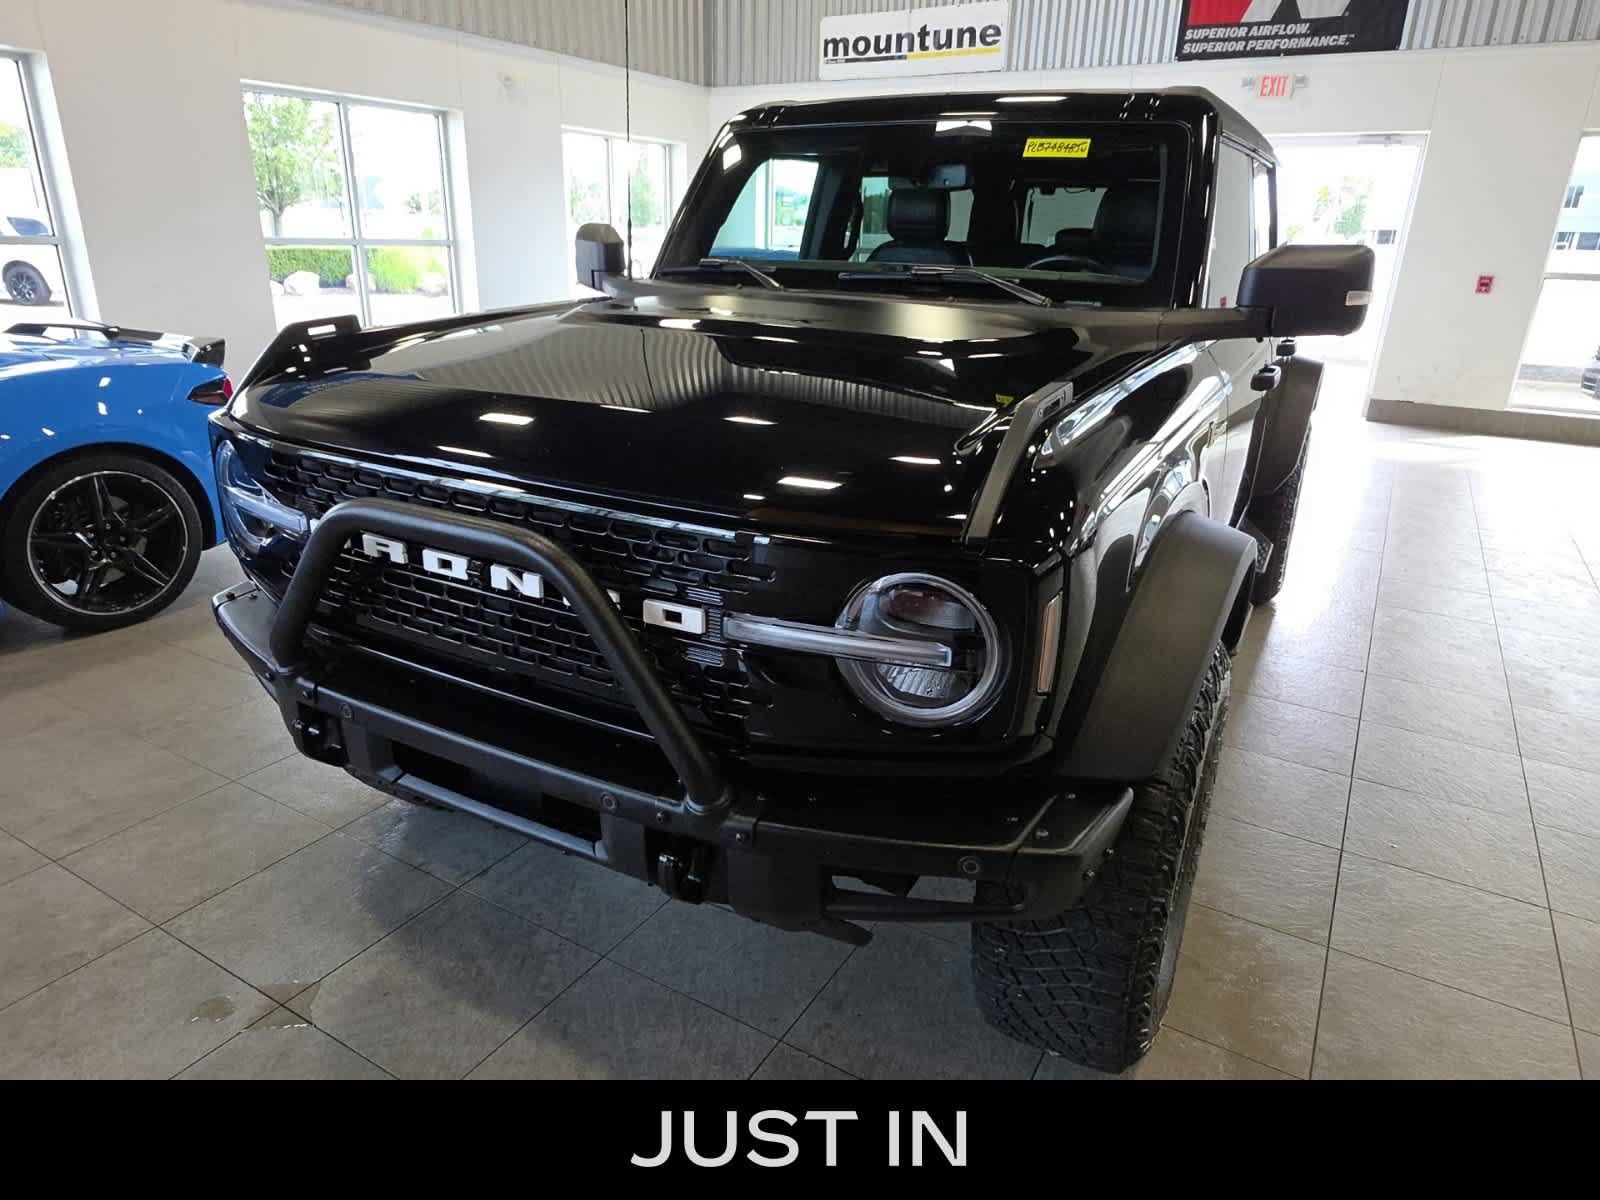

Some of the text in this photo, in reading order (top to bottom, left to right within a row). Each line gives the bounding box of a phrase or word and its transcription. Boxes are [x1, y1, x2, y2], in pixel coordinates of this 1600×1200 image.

[823, 24, 1002, 58] mountune
[1184, 23, 1311, 40] SUPERIOR AIRFLOW.
[1182, 41, 1245, 54] SUPERIOR
[1260, 75, 1288, 96] EXIT
[345, 532, 706, 634] RONO
